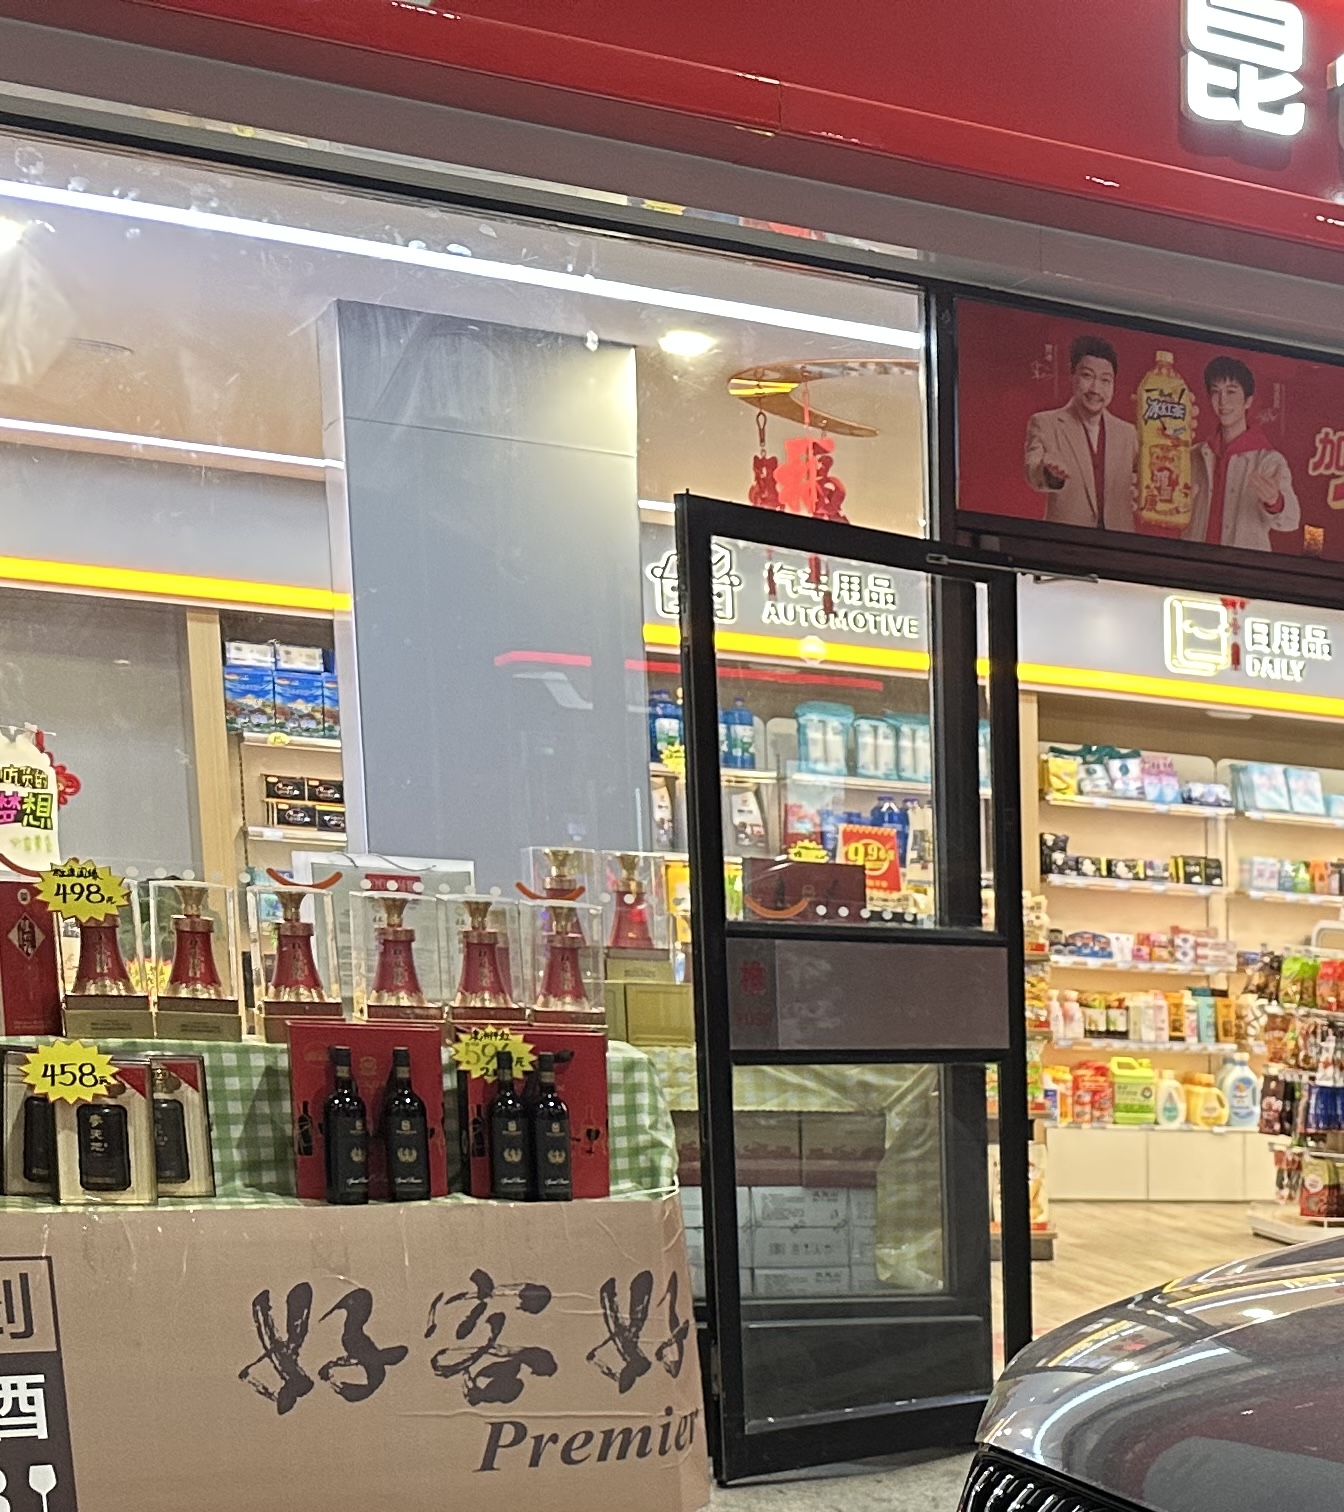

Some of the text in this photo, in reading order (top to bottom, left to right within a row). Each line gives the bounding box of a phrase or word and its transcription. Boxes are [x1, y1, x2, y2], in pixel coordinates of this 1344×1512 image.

[762, 601, 919, 638] AUTOMOTIVE
[1244, 617, 1332, 661] 日用品
[1245, 654, 1306, 682] DAILY
[472, 1405, 701, 1474] Premier
